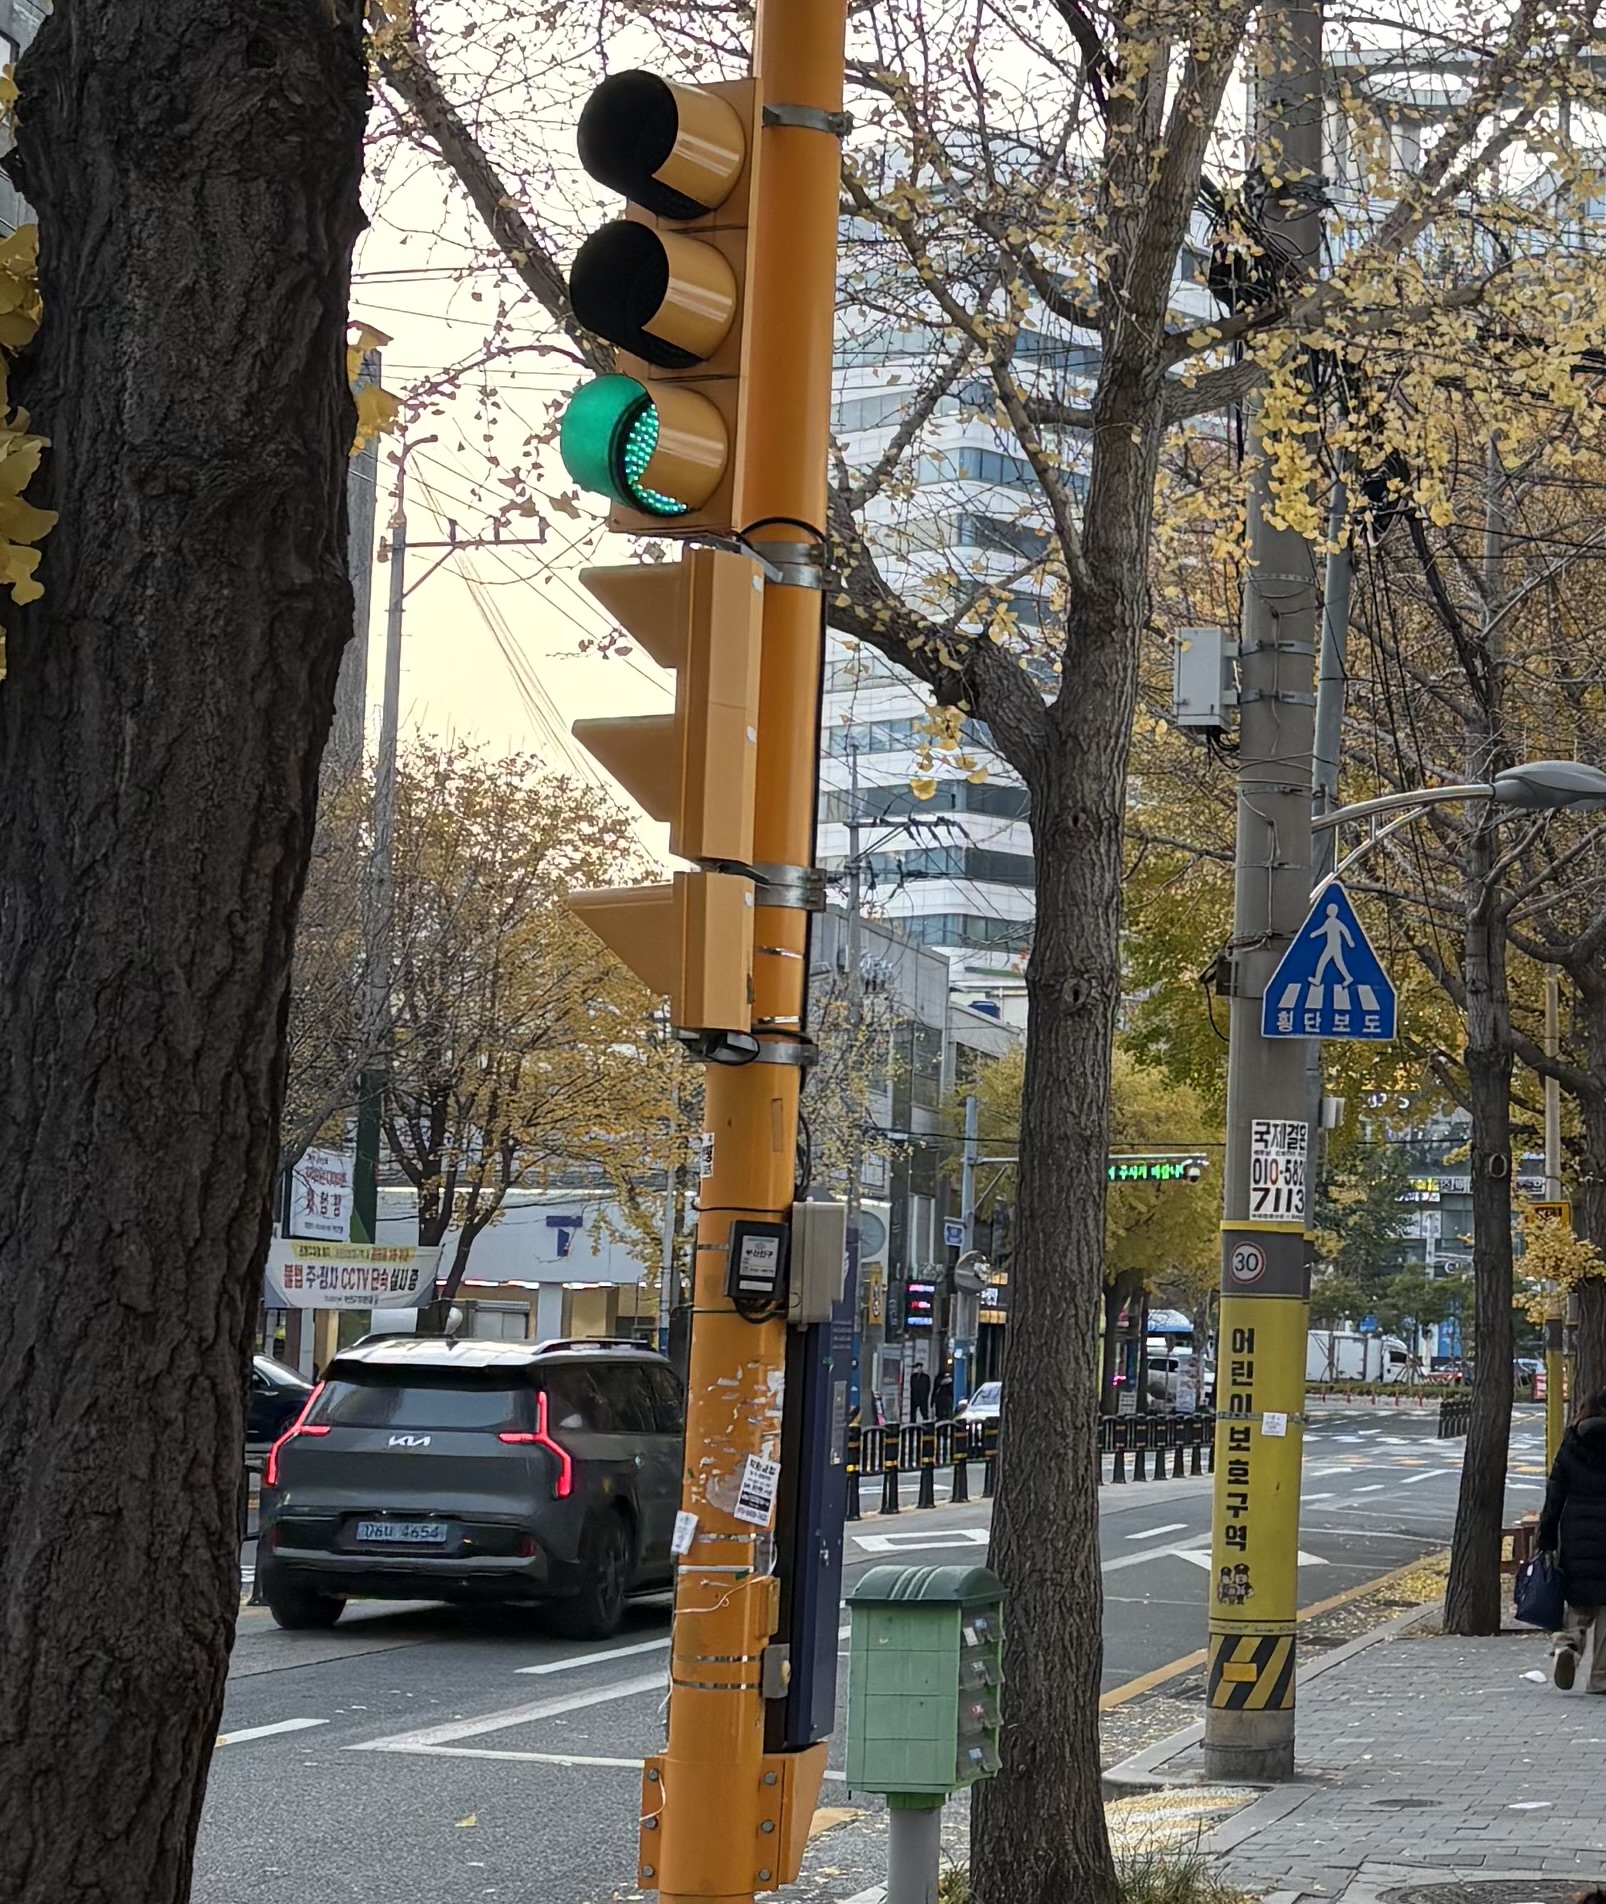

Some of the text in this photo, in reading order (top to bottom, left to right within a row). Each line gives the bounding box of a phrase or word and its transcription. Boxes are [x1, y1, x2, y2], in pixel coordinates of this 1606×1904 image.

[1277, 1010, 1382, 1034] 횡단보도
[1252, 1187, 1305, 1214] 7113
[1234, 1251, 1260, 1272] 30
[284, 1264, 303, 1289] 불법
[341, 1267, 369, 1292] CCTV
[371, 1268, 389, 1292] 단속
[1225, 1327, 1255, 1552] 어린이보호구역
